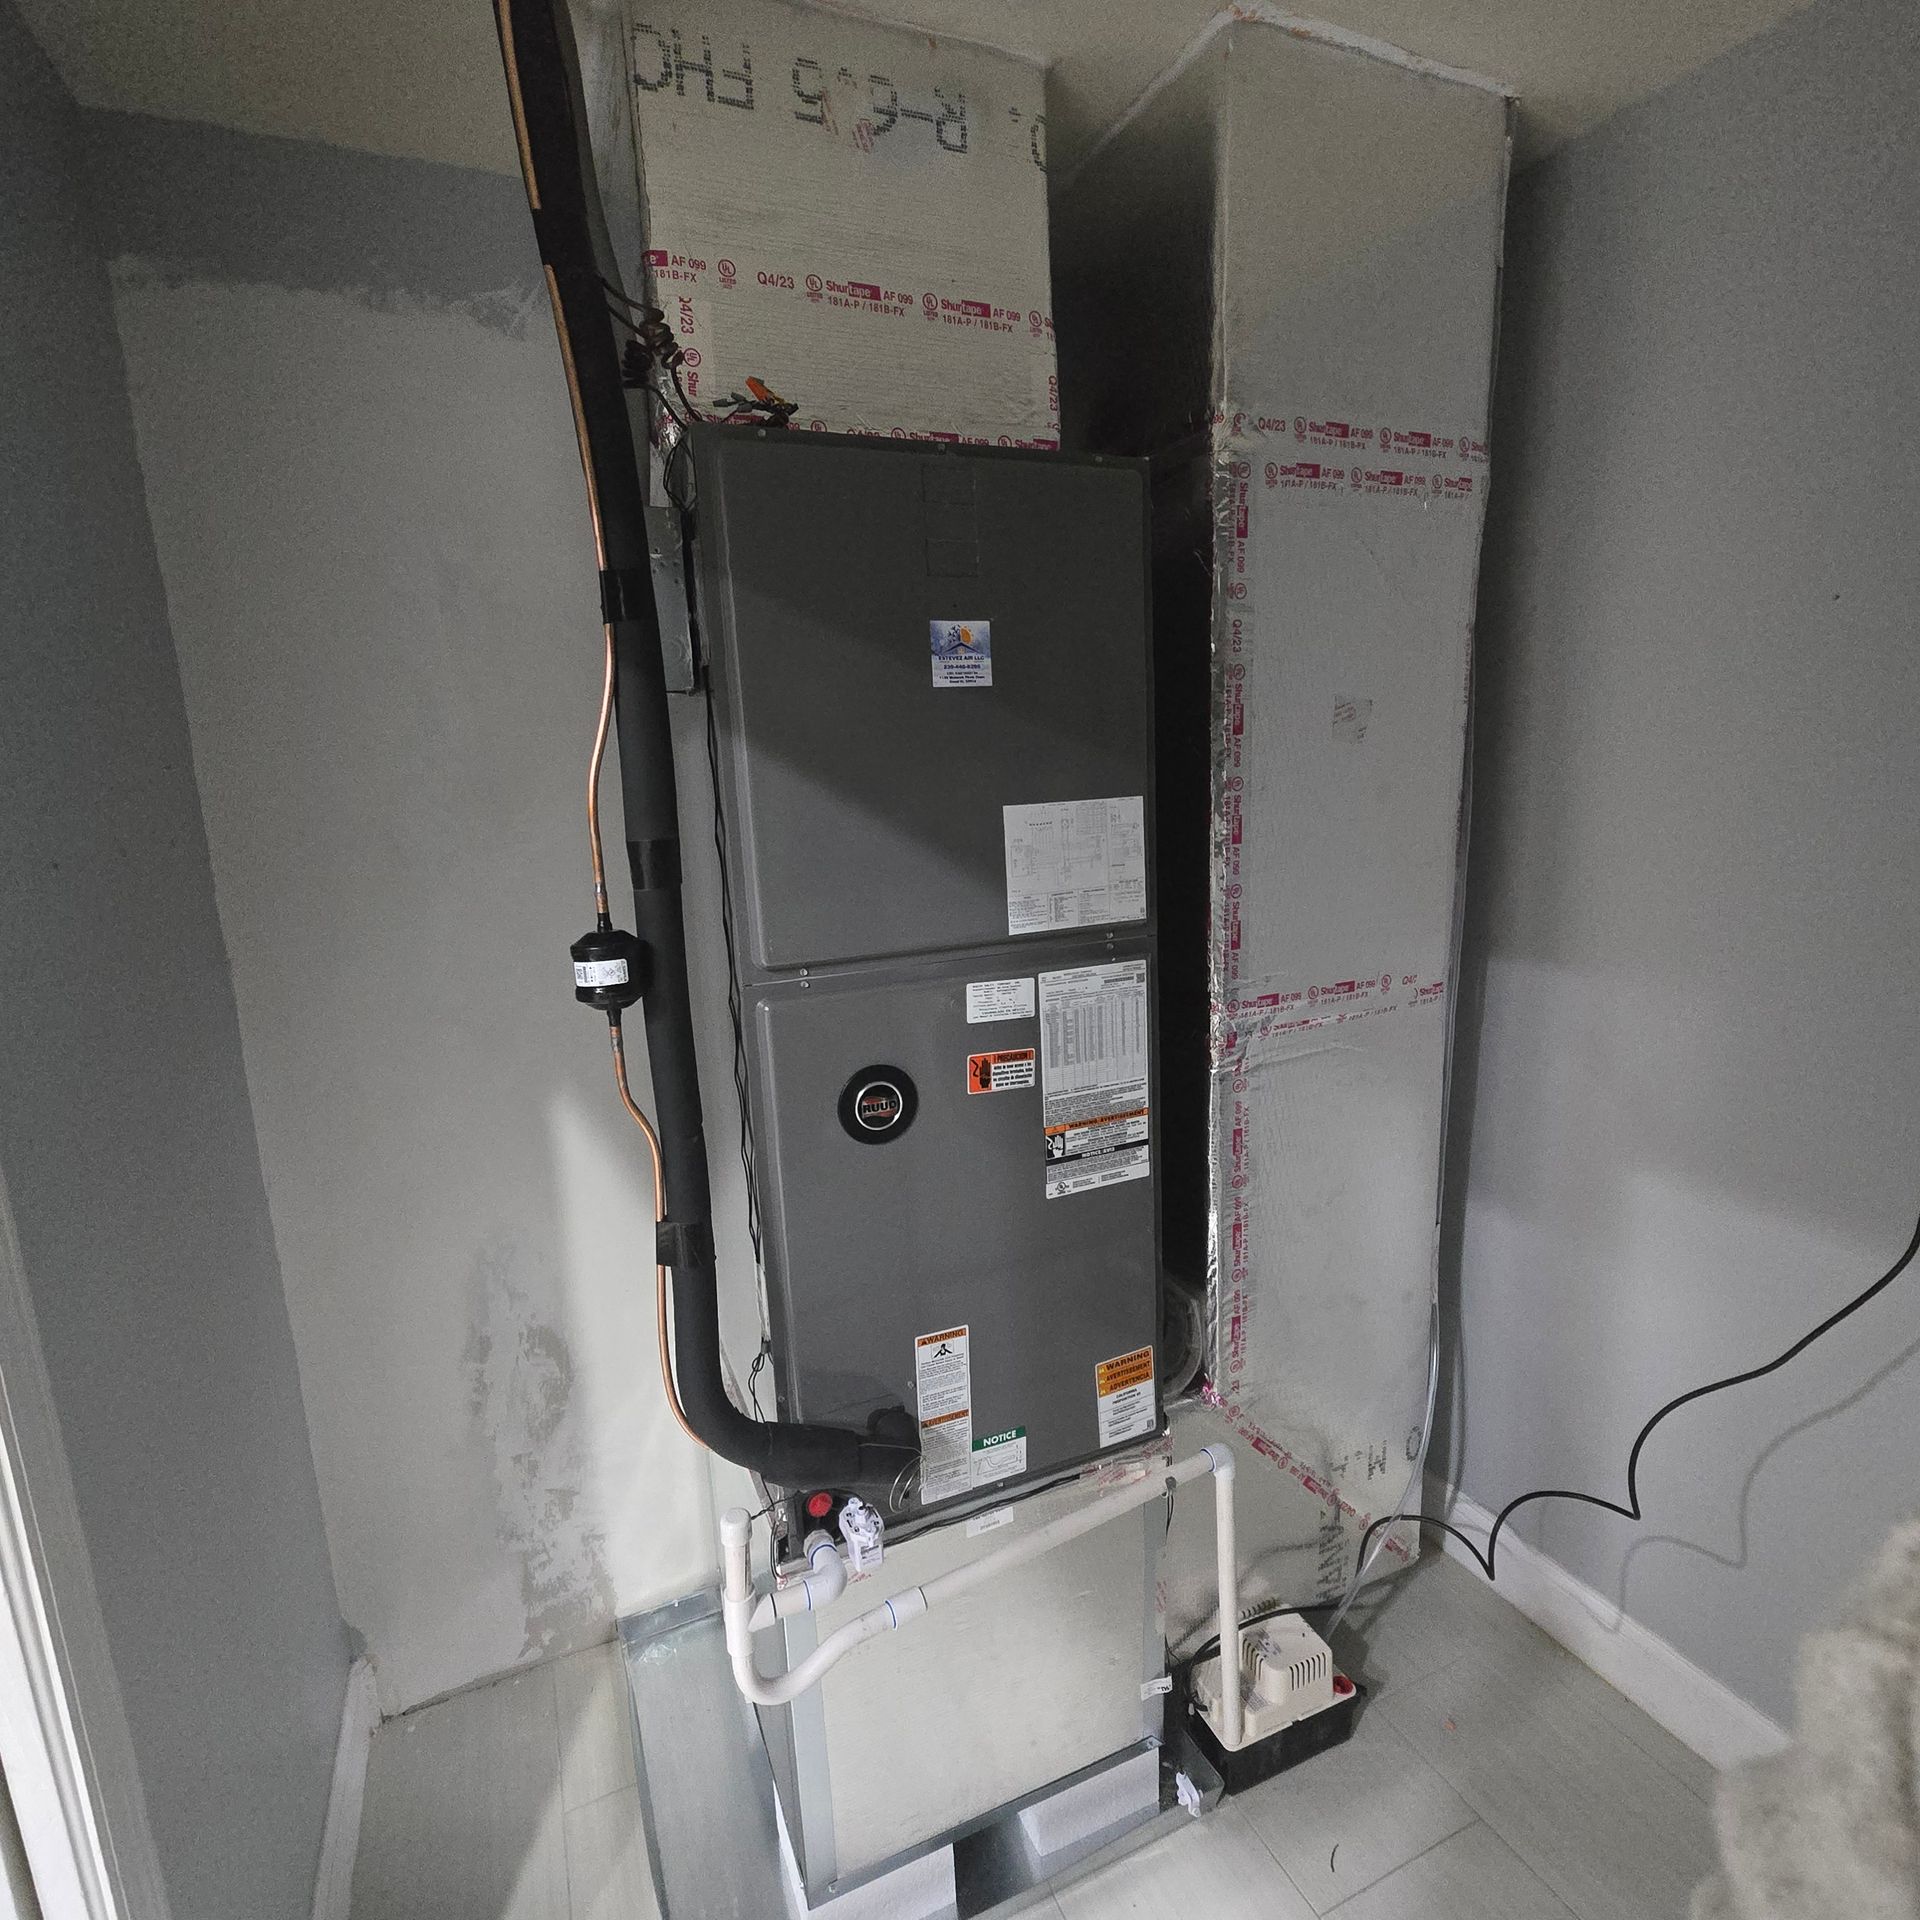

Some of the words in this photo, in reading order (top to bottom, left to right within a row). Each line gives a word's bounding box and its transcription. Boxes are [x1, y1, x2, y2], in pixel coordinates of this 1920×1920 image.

[672, 257, 686, 267] AF
[688, 258, 706, 270] 099
[655, 270, 697, 282] 181B-FX
[757, 272, 795, 289] Q4/23
[826, 280, 873, 299] Shurtape
[884, 290, 897, 301] AF
[898, 292, 913, 304] 099
[827, 295, 860, 308] 181A-P
[869, 302, 905, 317] 181B-FX
[941, 298, 984, 315] Shurtape
[993, 308, 1005, 318] AF
[1007, 310, 1021, 322] 099
[942, 314, 972, 327] 181A-P
[979, 319, 1013, 333] 181B-FX
[1258, 417, 1286, 432] Q4/23
[1233, 620, 1242, 654] Q4/23
[863, 1100, 897, 1113] RUUD
[927, 1330, 964, 1345] WARNING
[1106, 1350, 1150, 1371] WARNING
[1106, 1361, 1151, 1382] AVERTISSEMENT
[1109, 1372, 1150, 1391] ADVERTENCIA
[983, 1429, 1017, 1447] NOTICE
